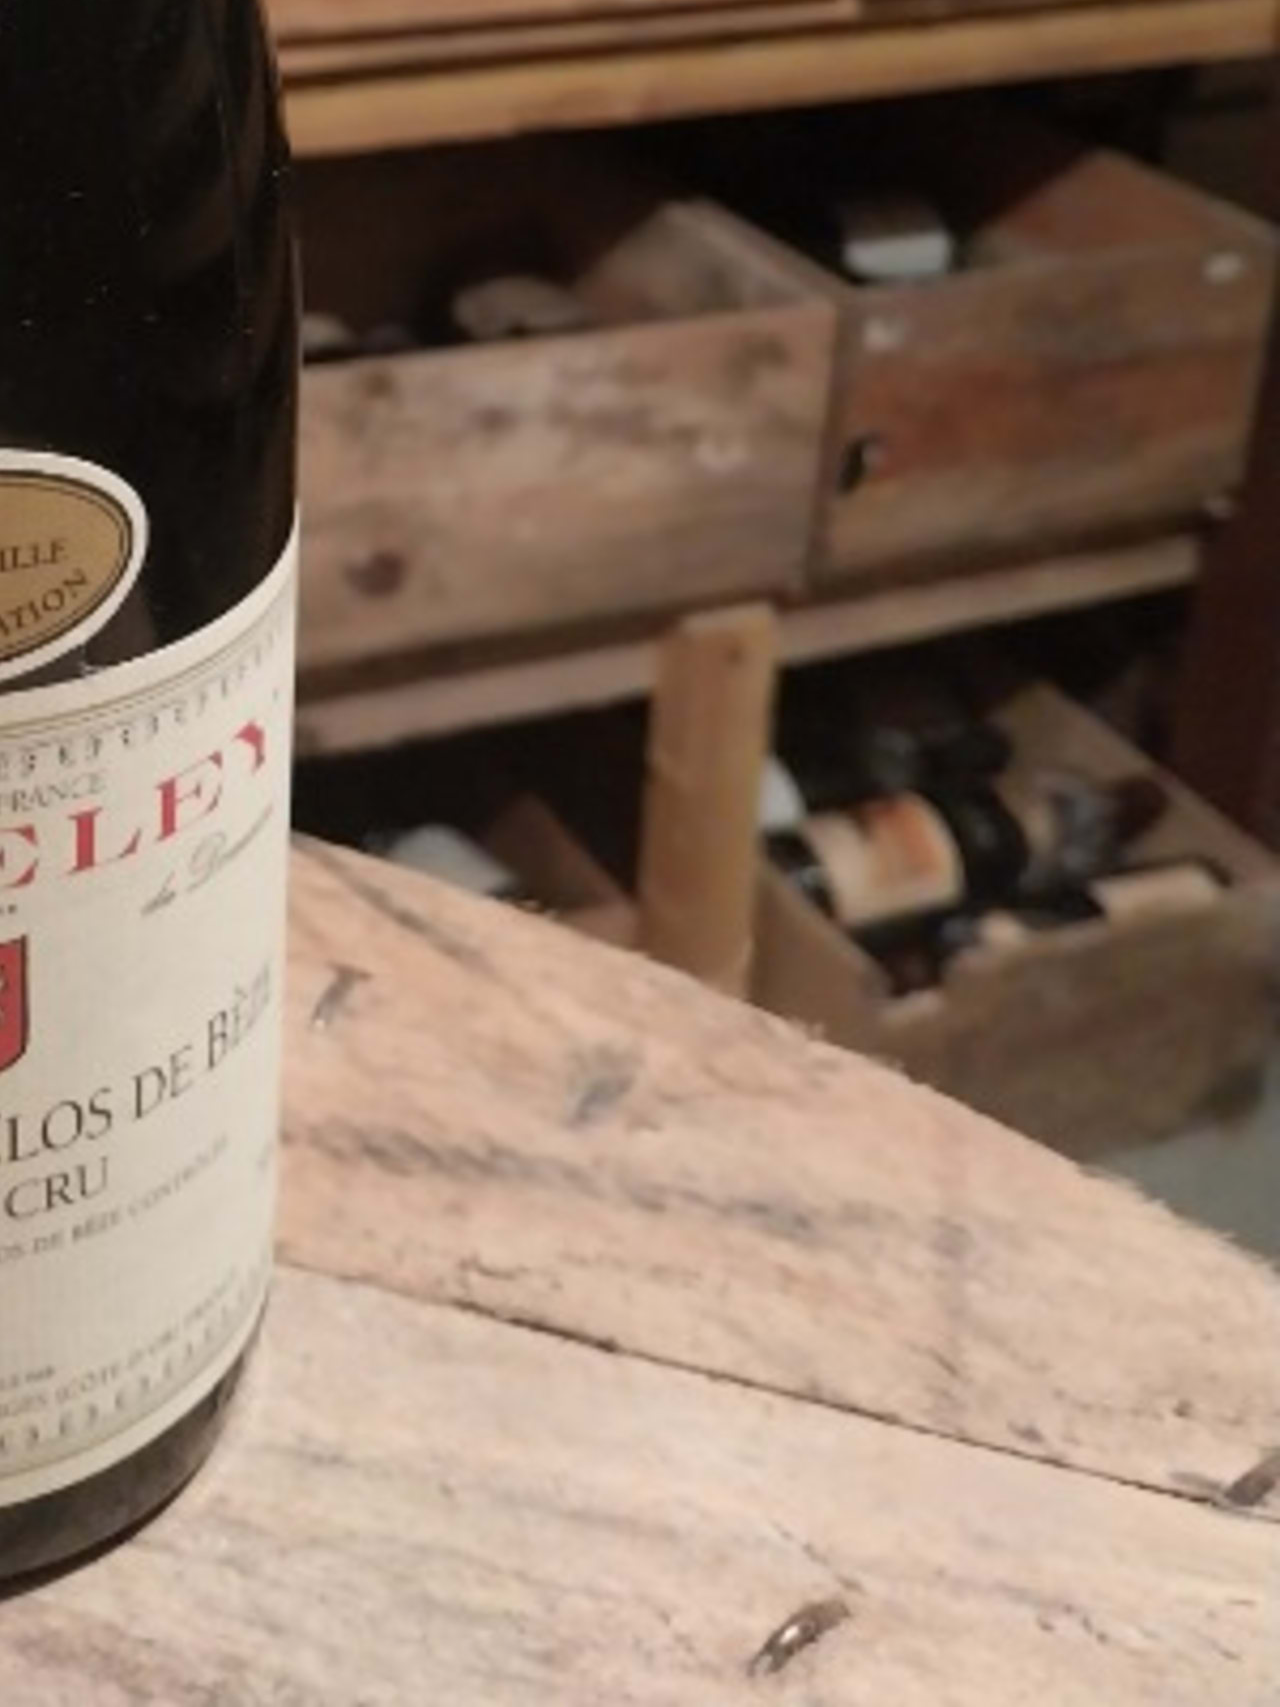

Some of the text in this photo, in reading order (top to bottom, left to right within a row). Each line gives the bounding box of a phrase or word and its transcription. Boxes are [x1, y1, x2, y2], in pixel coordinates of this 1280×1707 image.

[133, 1043, 195, 1122] DE
[3, 1155, 109, 1221] CRU
[33, 1232, 64, 1254] DE
